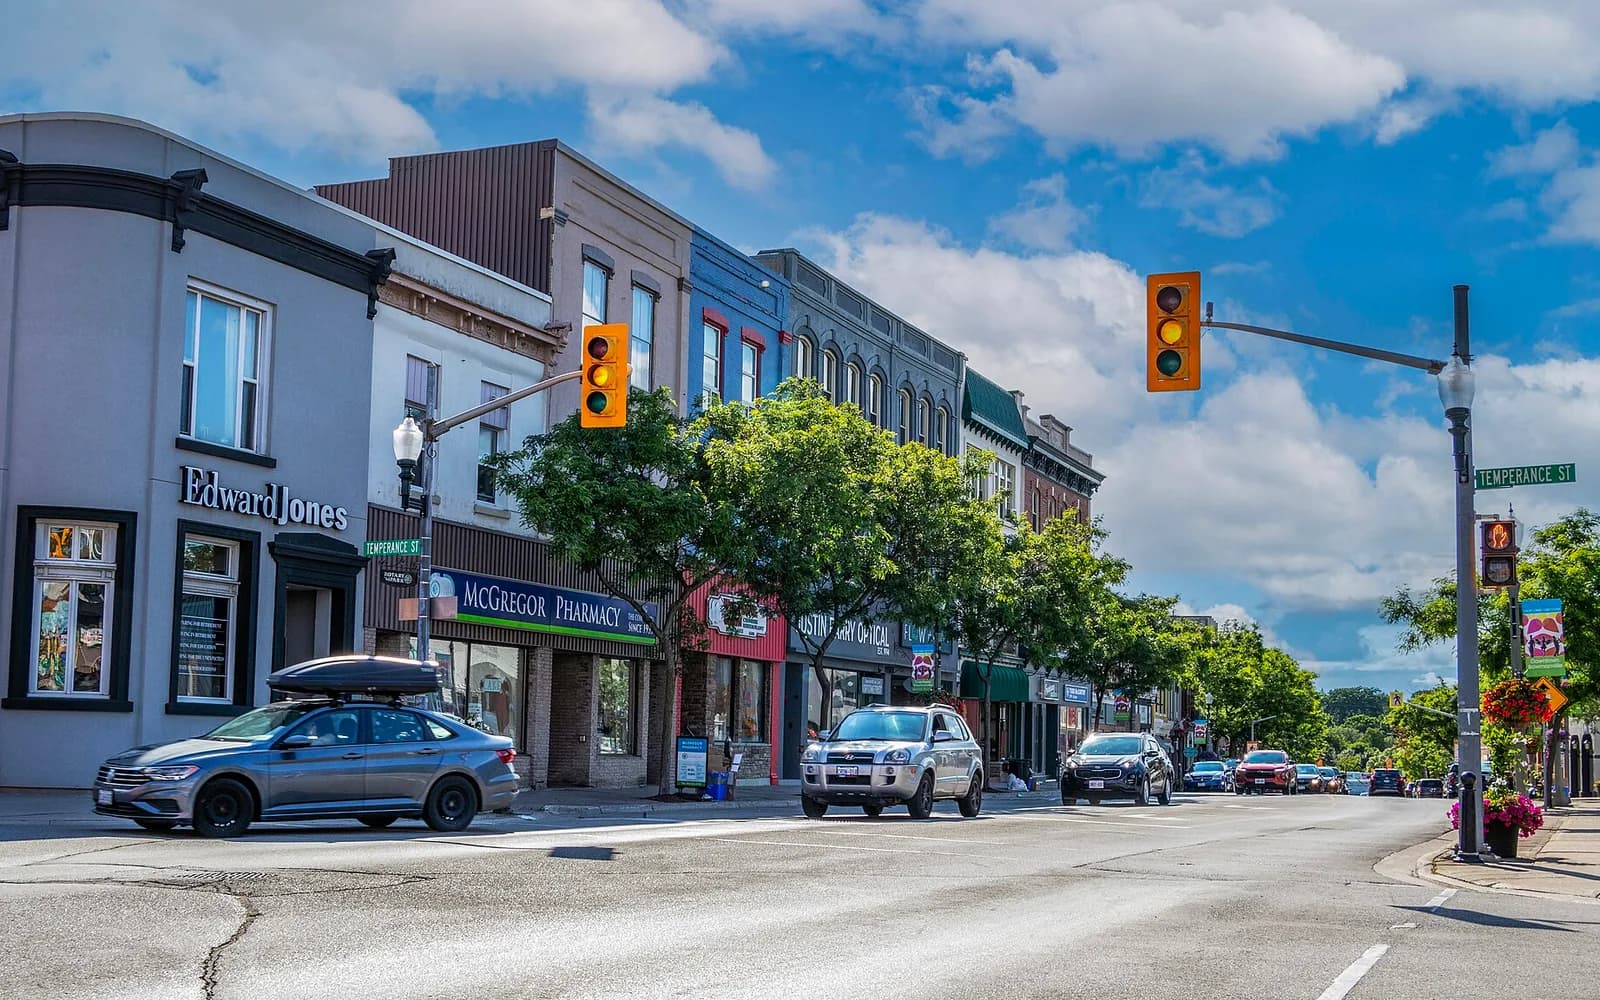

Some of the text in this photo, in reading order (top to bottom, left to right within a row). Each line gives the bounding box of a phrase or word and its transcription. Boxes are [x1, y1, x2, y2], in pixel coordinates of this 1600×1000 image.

[1480, 465, 1571, 486] TEMPERANCE ST
[366, 540, 419, 555] TEMPERANCE ST
[555, 595, 621, 627] PHARMACY
[857, 621, 890, 647] OPTICAL
